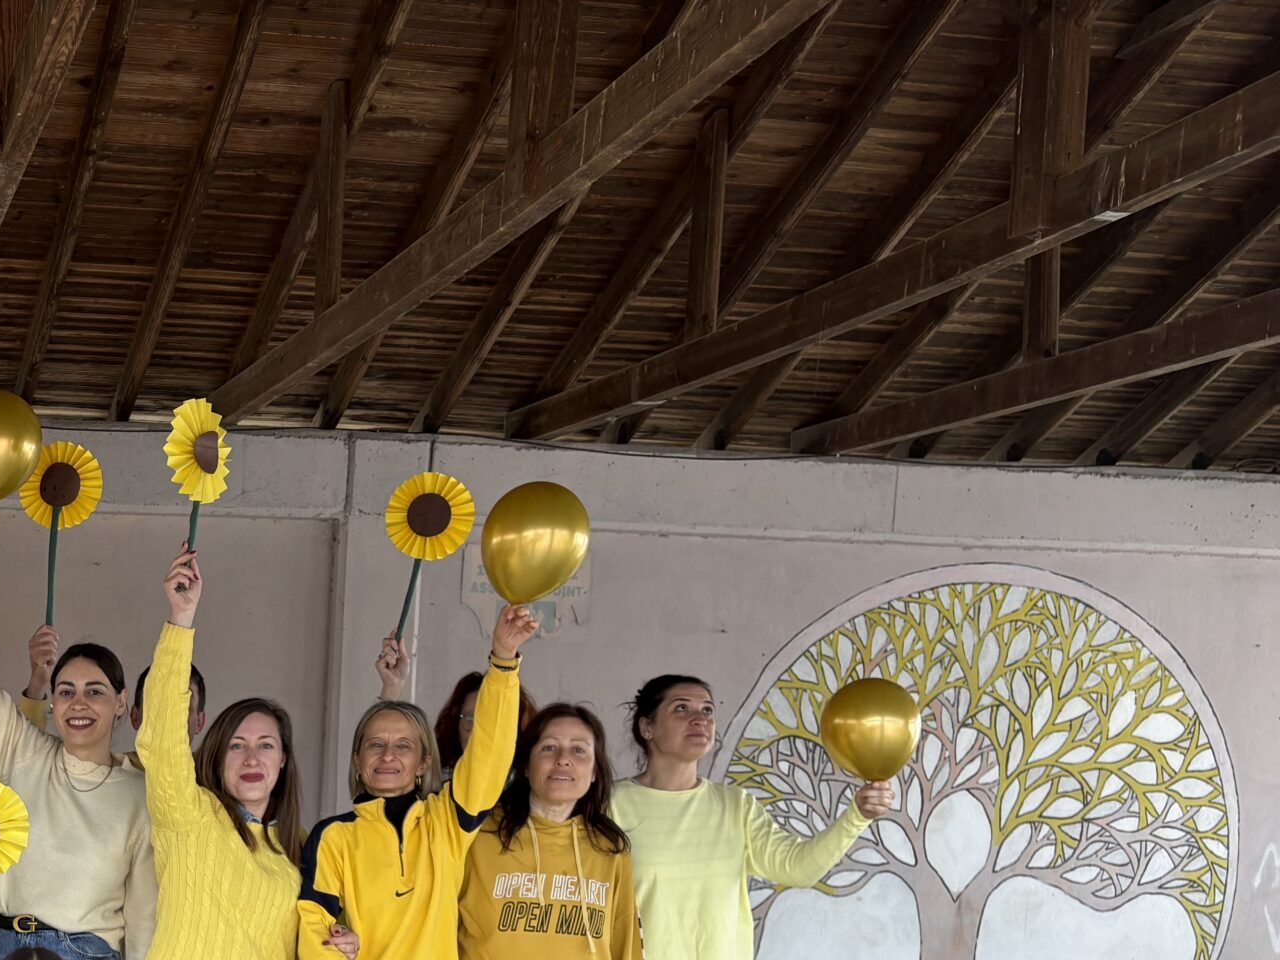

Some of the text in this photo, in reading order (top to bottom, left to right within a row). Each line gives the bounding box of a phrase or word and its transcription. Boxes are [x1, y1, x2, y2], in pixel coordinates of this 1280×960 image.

[493, 872, 609, 907] OPEN HEART
[498, 901, 606, 939] OPEN MIND
